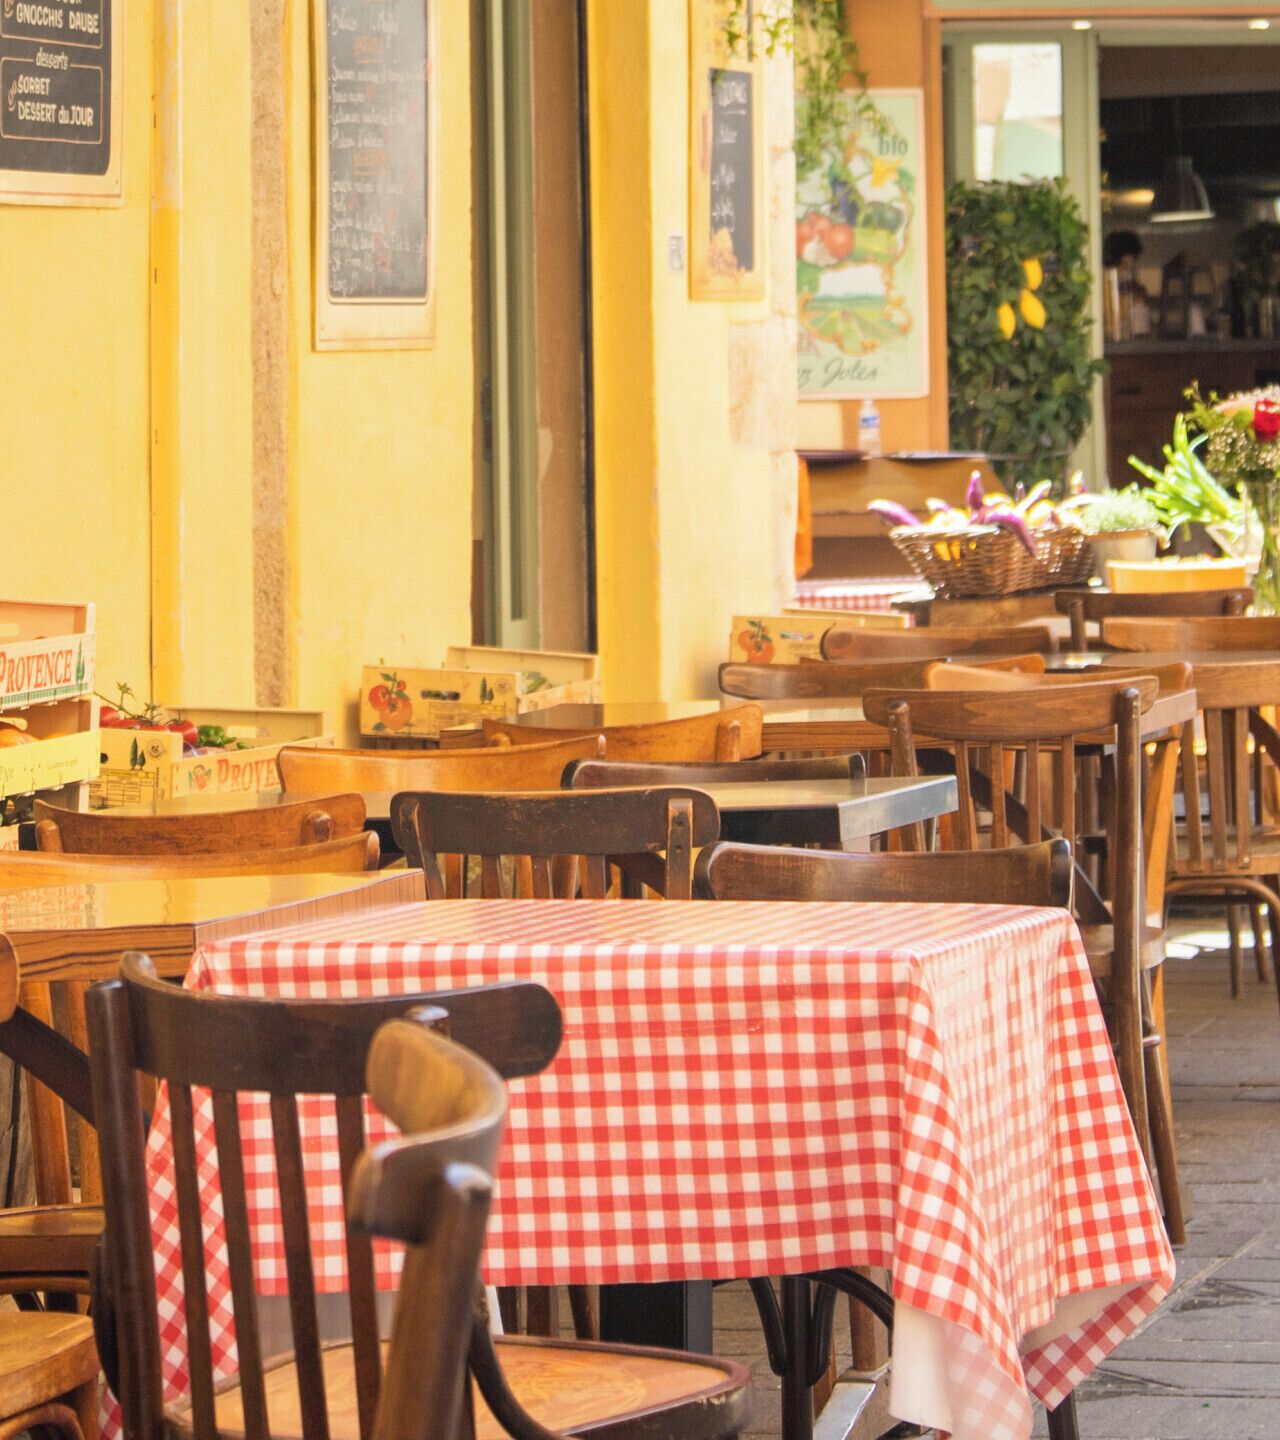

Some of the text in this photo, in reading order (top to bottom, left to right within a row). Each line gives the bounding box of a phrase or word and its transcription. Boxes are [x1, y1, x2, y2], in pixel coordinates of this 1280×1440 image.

[16, 3, 99, 34] GNOCCHIS DAUBE
[35, 47, 69, 71] desserts
[17, 75, 50, 96] SORBET
[17, 101, 94, 127] DESSERT du JOUR
[216, 757, 281, 792] PROVE
